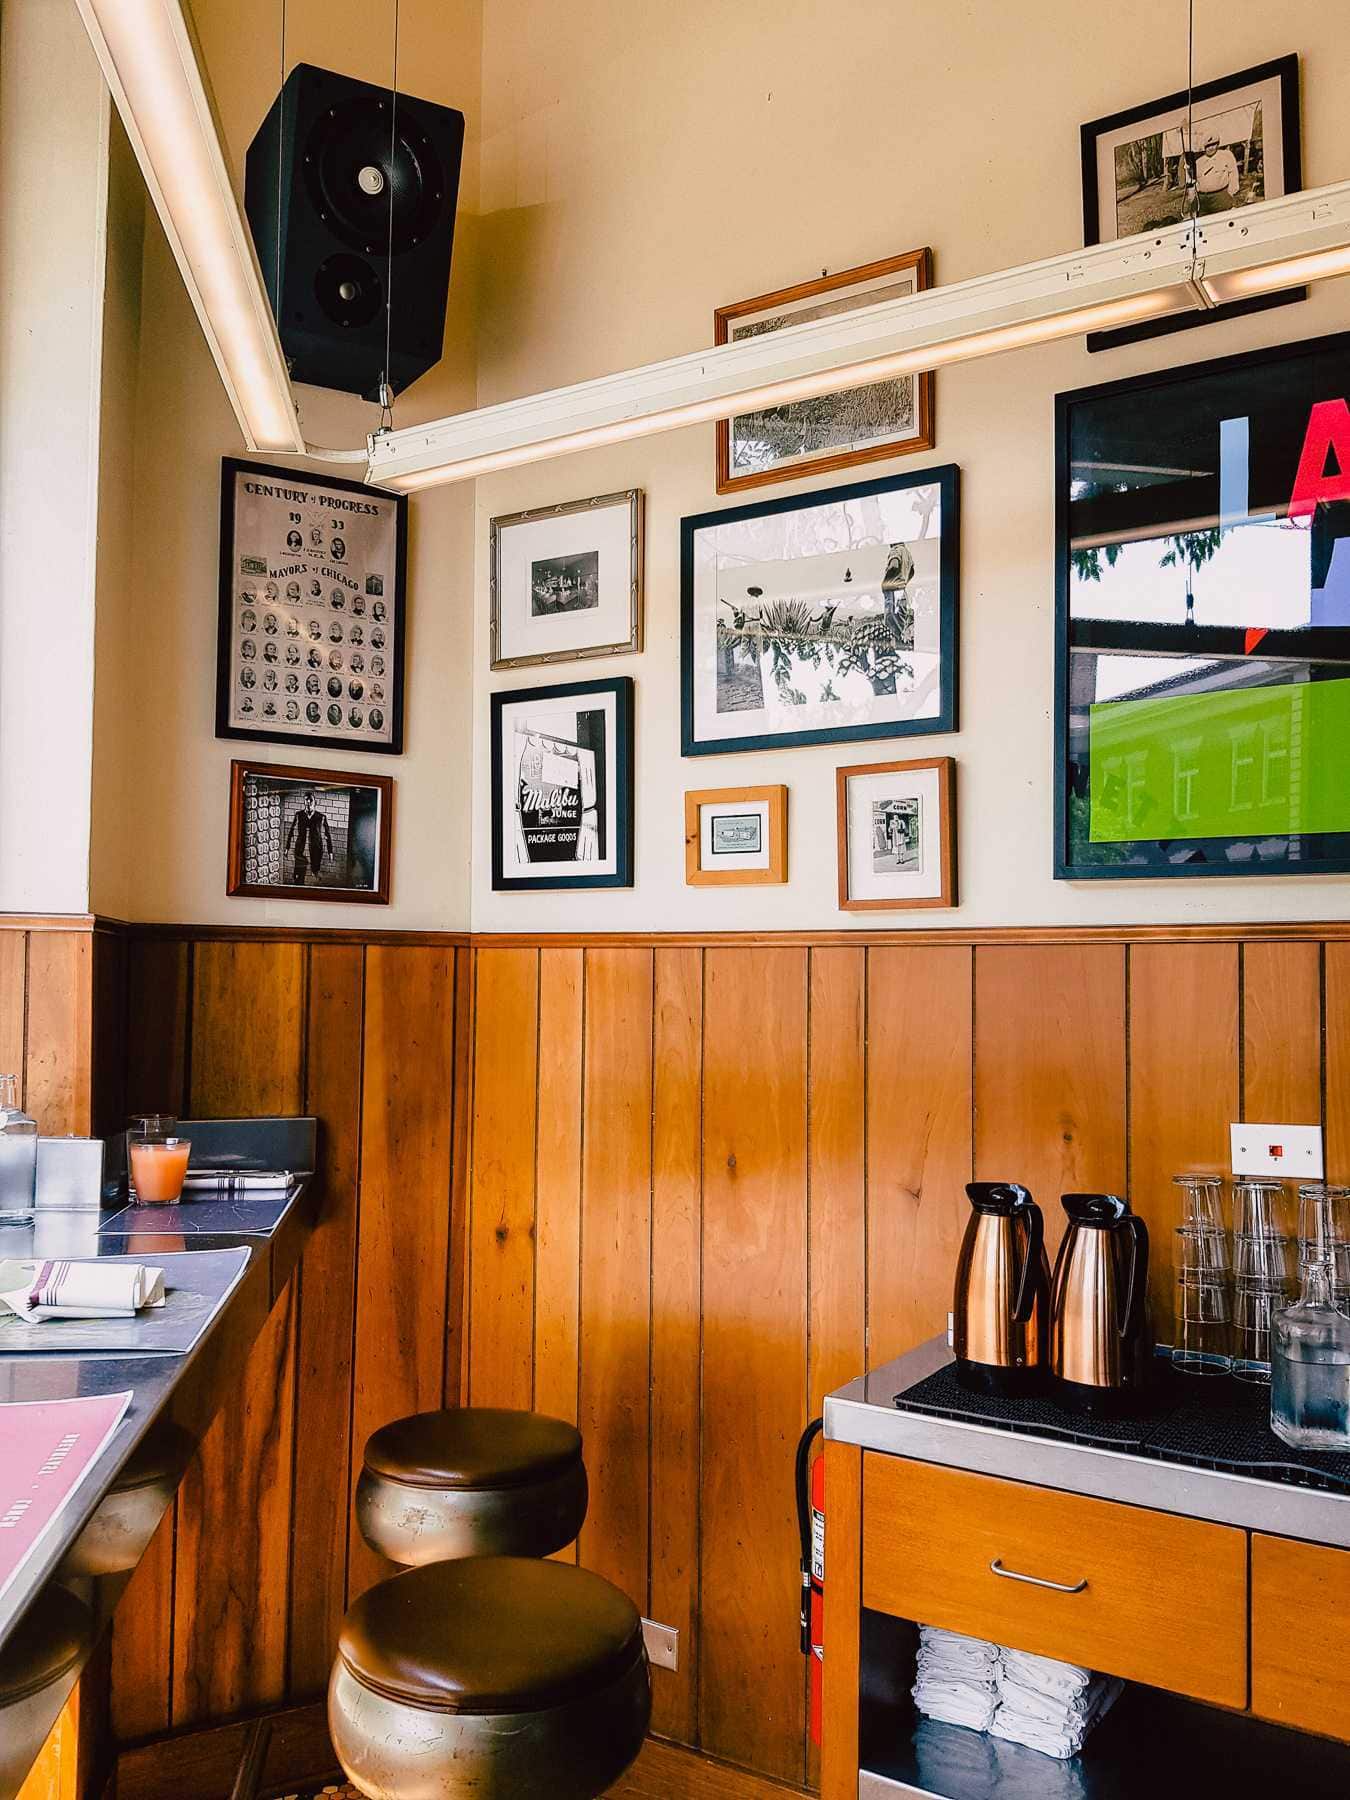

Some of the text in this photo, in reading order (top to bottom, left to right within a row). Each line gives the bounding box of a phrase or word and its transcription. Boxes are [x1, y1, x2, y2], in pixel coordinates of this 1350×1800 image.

[245, 482, 308, 504] CENTURY
[318, 495, 379, 516] PROGRESS
[288, 512, 345, 530] 19 33
[269, 563, 308, 579] MAYORS
[321, 566, 359, 591] CHICAGO
[522, 788, 578, 812] Malibu
[527, 832, 577, 844] PACKAGE GOODS
